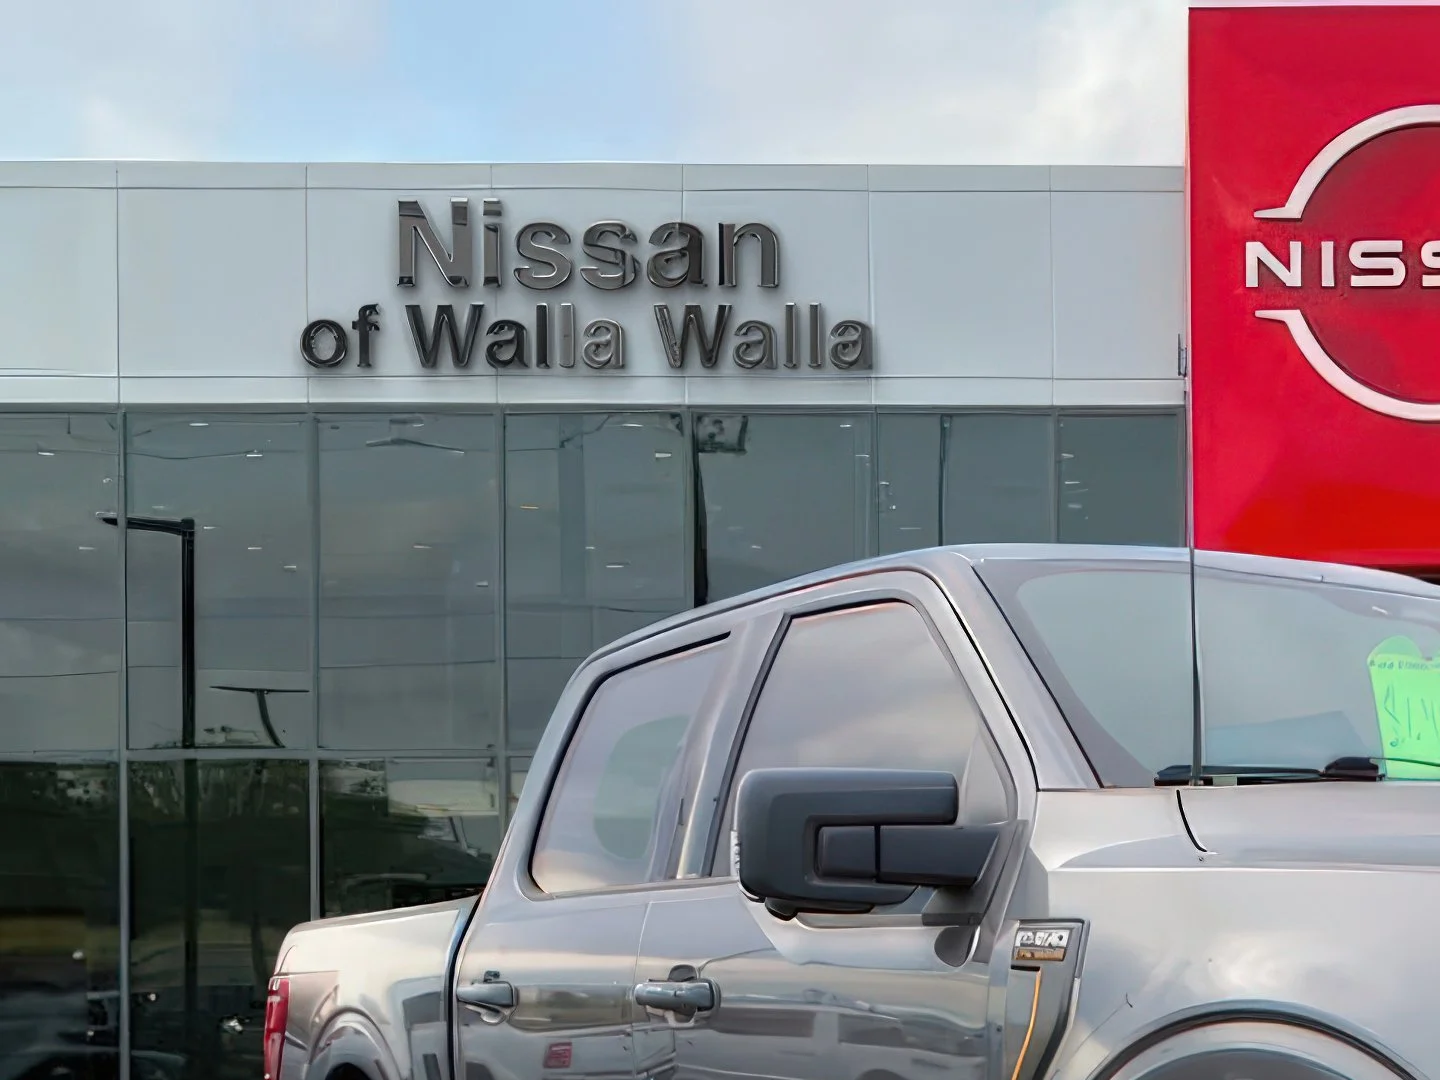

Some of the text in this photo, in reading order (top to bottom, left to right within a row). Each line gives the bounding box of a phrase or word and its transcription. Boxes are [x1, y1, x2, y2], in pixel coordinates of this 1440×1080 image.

[397, 197, 782, 289] Nissan
[299, 302, 874, 370] of Walla Walla
